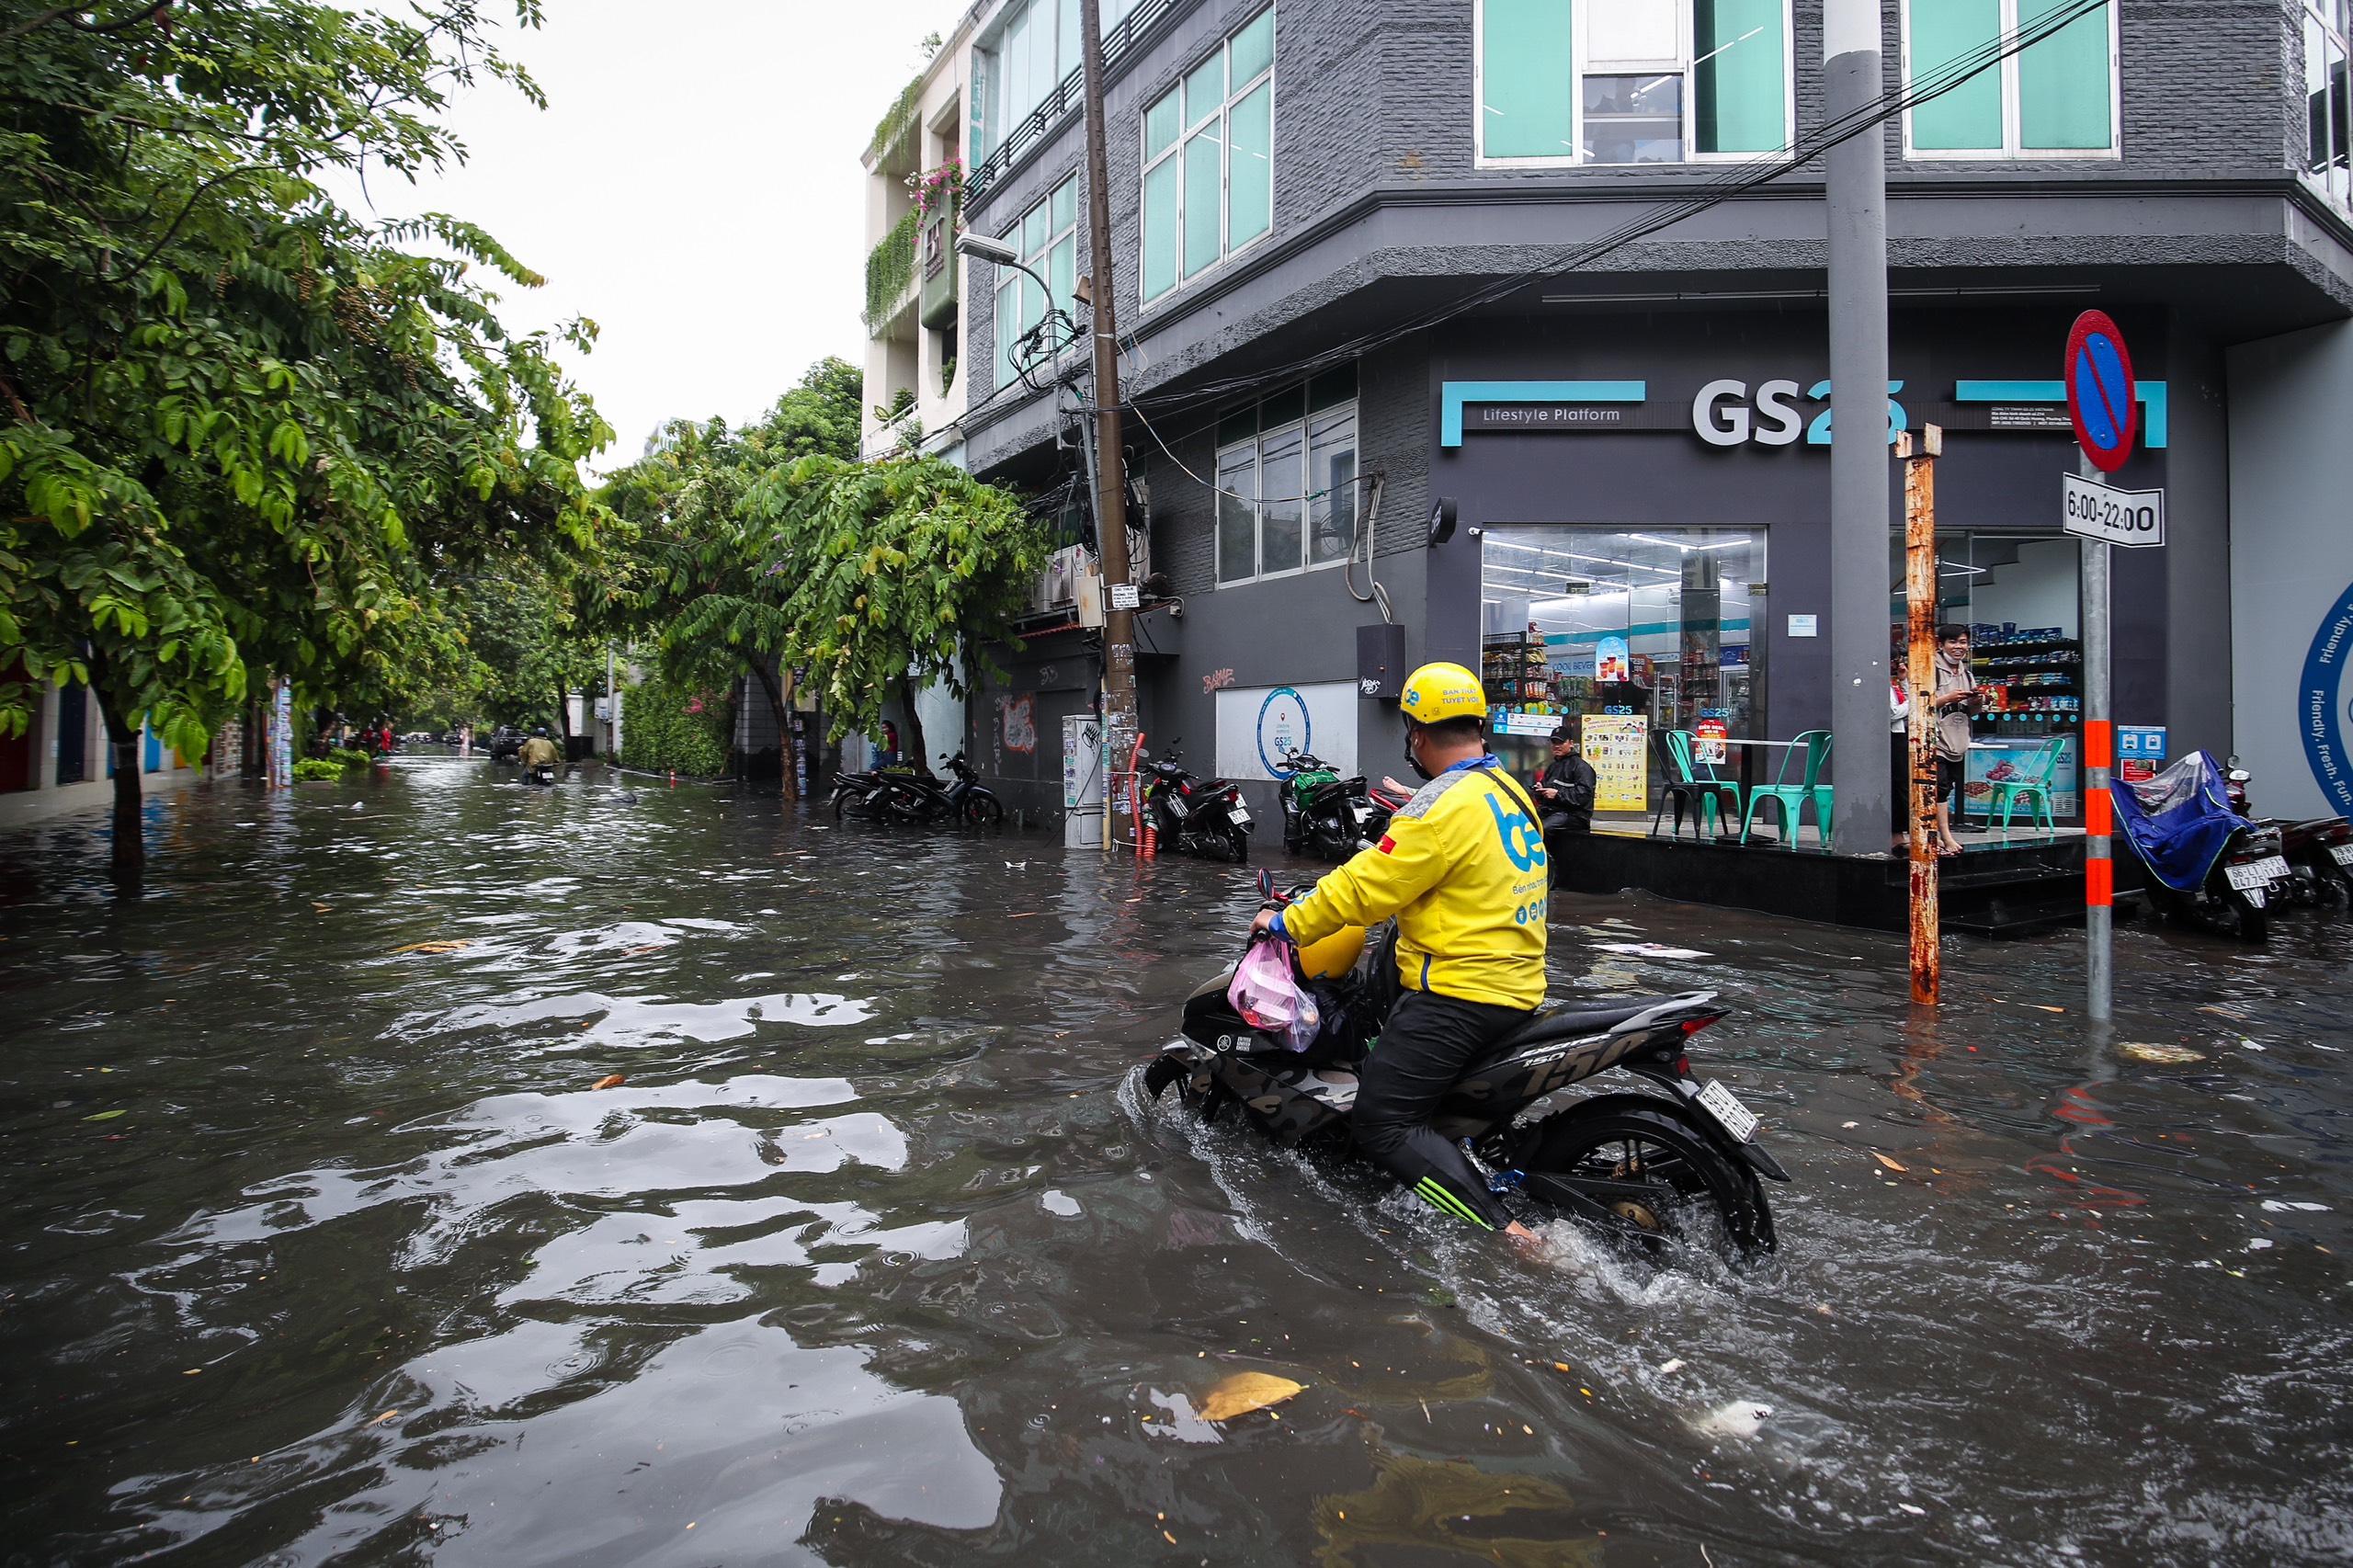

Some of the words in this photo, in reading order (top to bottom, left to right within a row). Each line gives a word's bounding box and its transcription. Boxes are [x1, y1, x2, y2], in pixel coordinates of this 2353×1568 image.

[1483, 408, 1540, 424] Lifestyle
[1554, 408, 1620, 421] Platform
[2067, 490, 2154, 532] 6:00-22:00
[1604, 704, 1632, 715] GS25
[1699, 707, 1730, 718] GS25
[1274, 736, 1292, 747] GS25
[1483, 792, 1546, 873] be
[1522, 1051, 1566, 1068] 150
